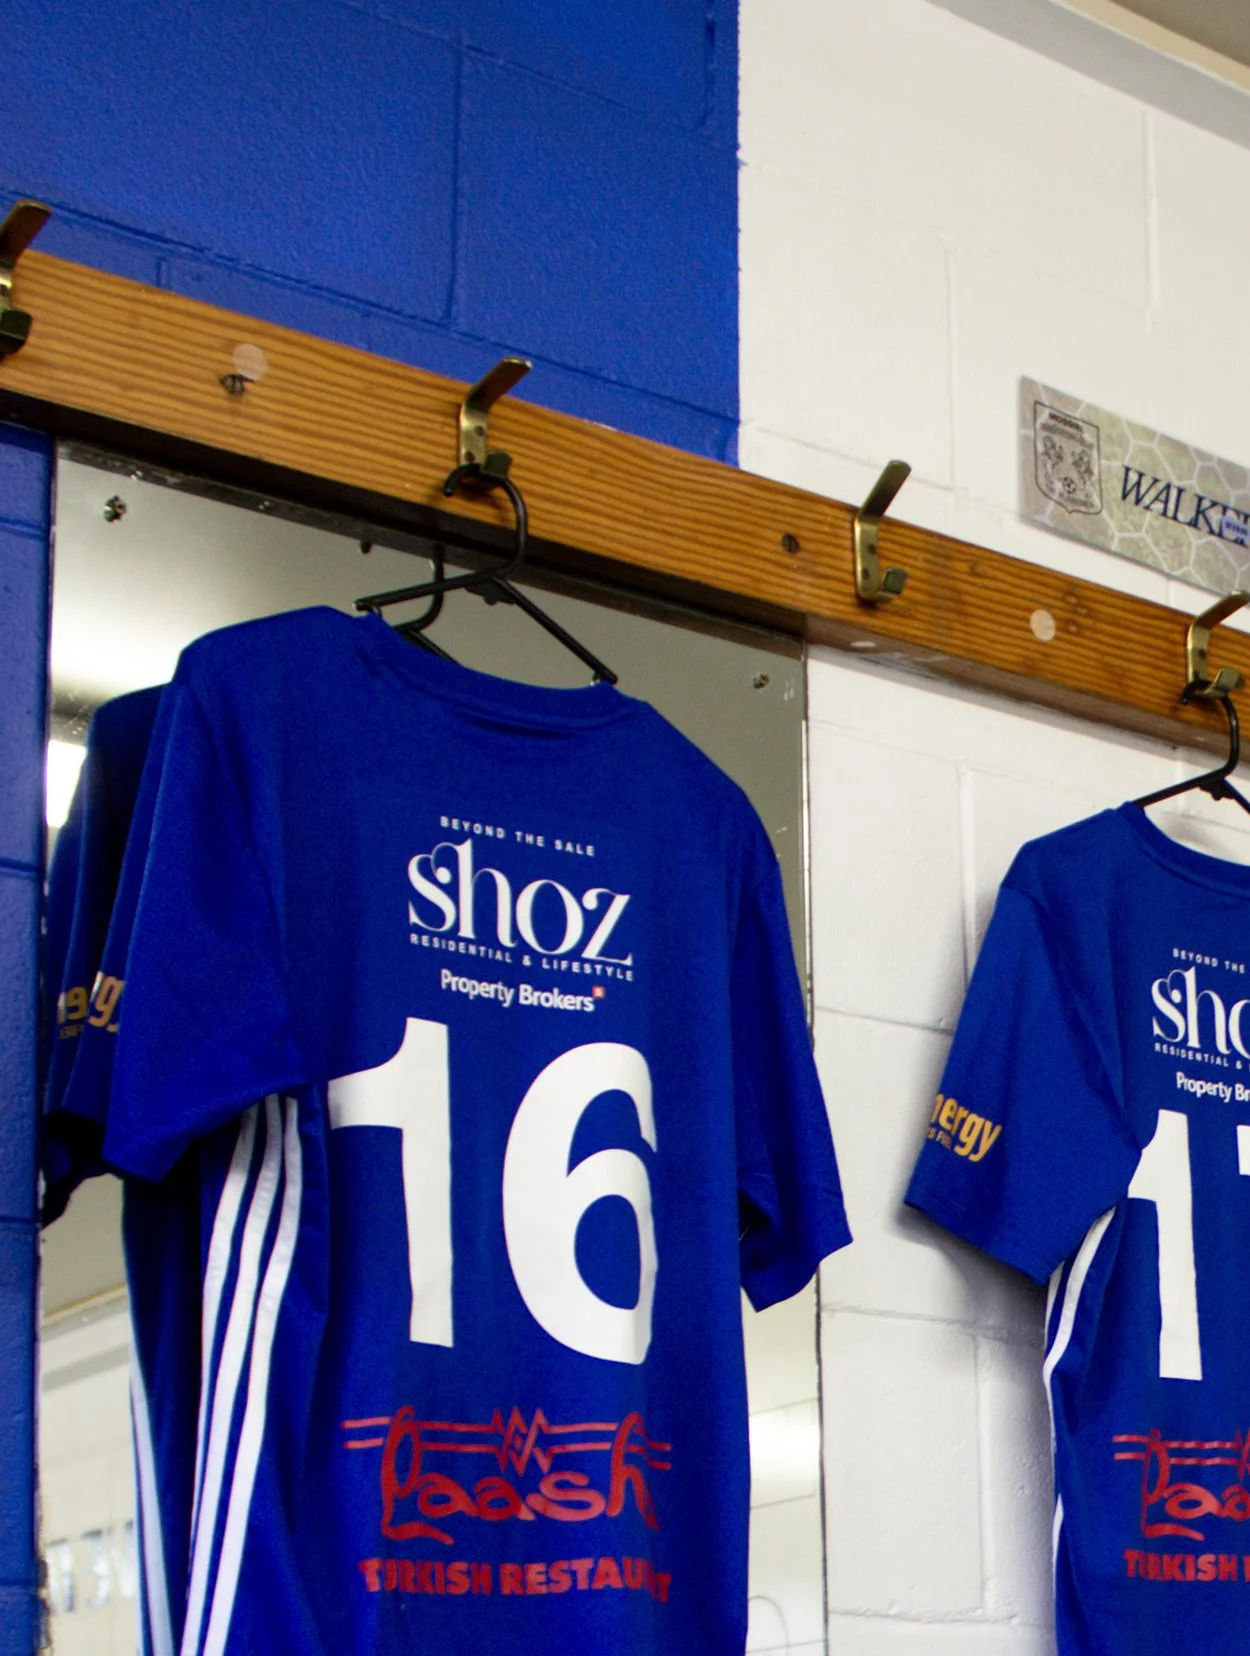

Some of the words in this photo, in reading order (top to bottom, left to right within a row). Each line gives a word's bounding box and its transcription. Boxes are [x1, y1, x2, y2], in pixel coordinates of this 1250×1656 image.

[439, 815, 506, 839] BEYOND
[515, 831, 545, 848] THE
[554, 839, 596, 857] SALE
[407, 838, 633, 967] shoz
[410, 932, 513, 964] RESIDENTIAL
[521, 954, 532, 967] &
[541, 957, 635, 981] LIFESTYLE
[1172, 947, 1219, 967] BEYOND
[1224, 960, 1245, 974] THE
[440, 968, 514, 1008] Property
[518, 983, 596, 1012] Brokers
[1154, 1042, 1229, 1067] RESIDENTIAL
[1235, 1059, 1242, 1070] &
[1175, 1071, 1233, 1103] Property
[328, 1017, 657, 1365] 16
